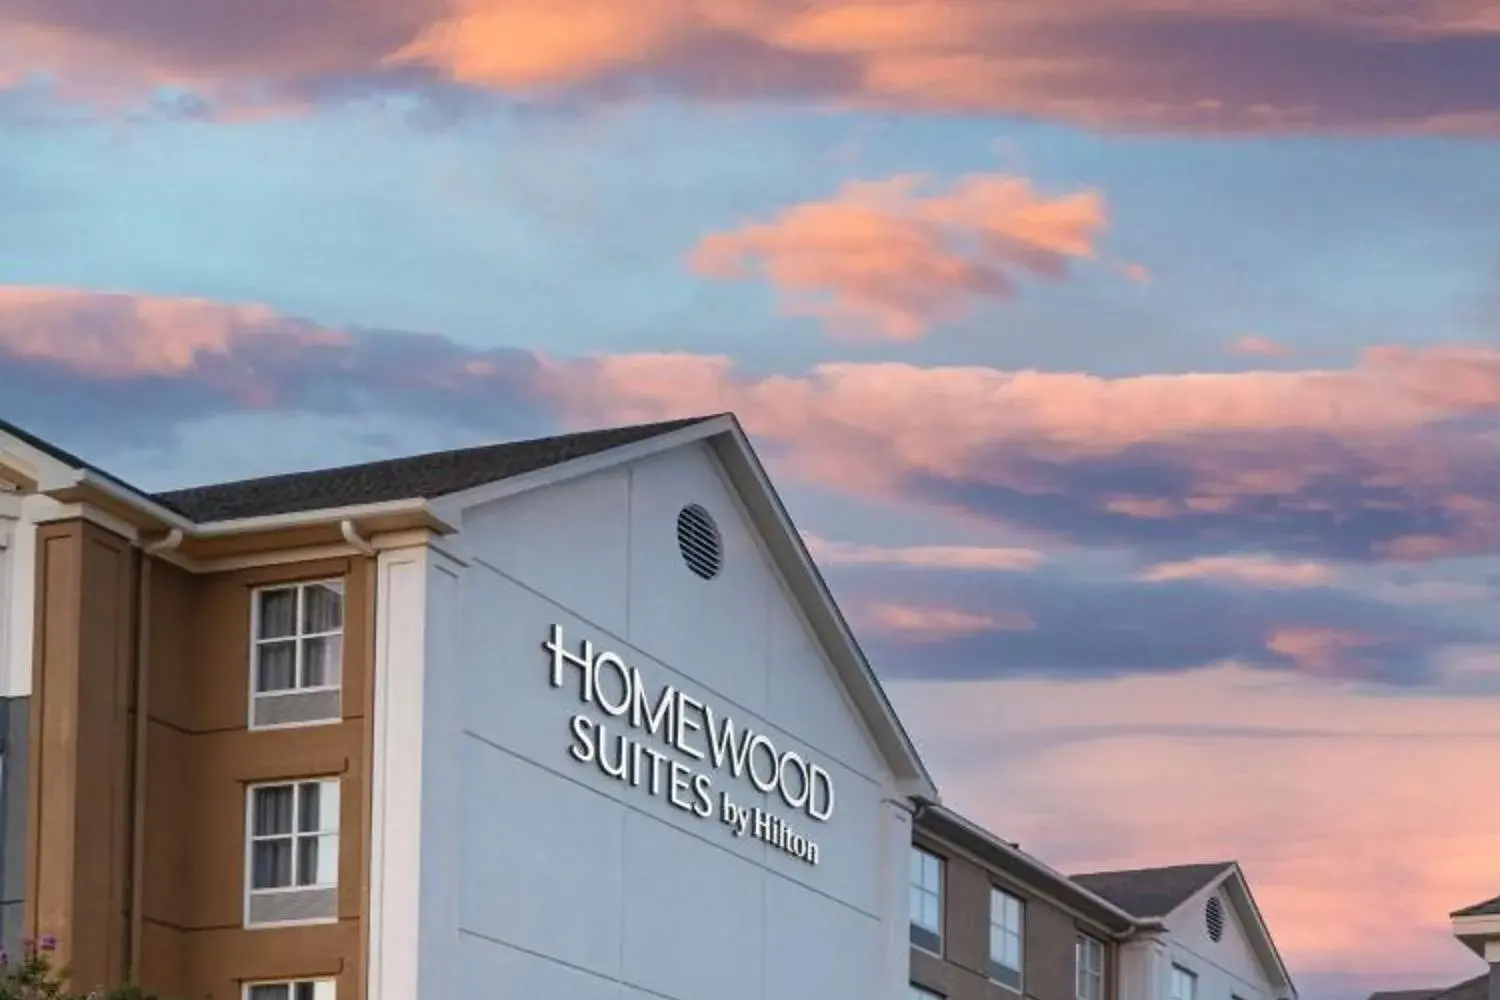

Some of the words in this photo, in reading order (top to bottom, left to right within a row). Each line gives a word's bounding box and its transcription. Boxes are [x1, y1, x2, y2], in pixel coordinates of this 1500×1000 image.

[543, 623, 834, 821] HOMEWOOD
[569, 714, 712, 818] SUITES
[720, 791, 749, 836] by
[750, 807, 819, 865] Hilton
